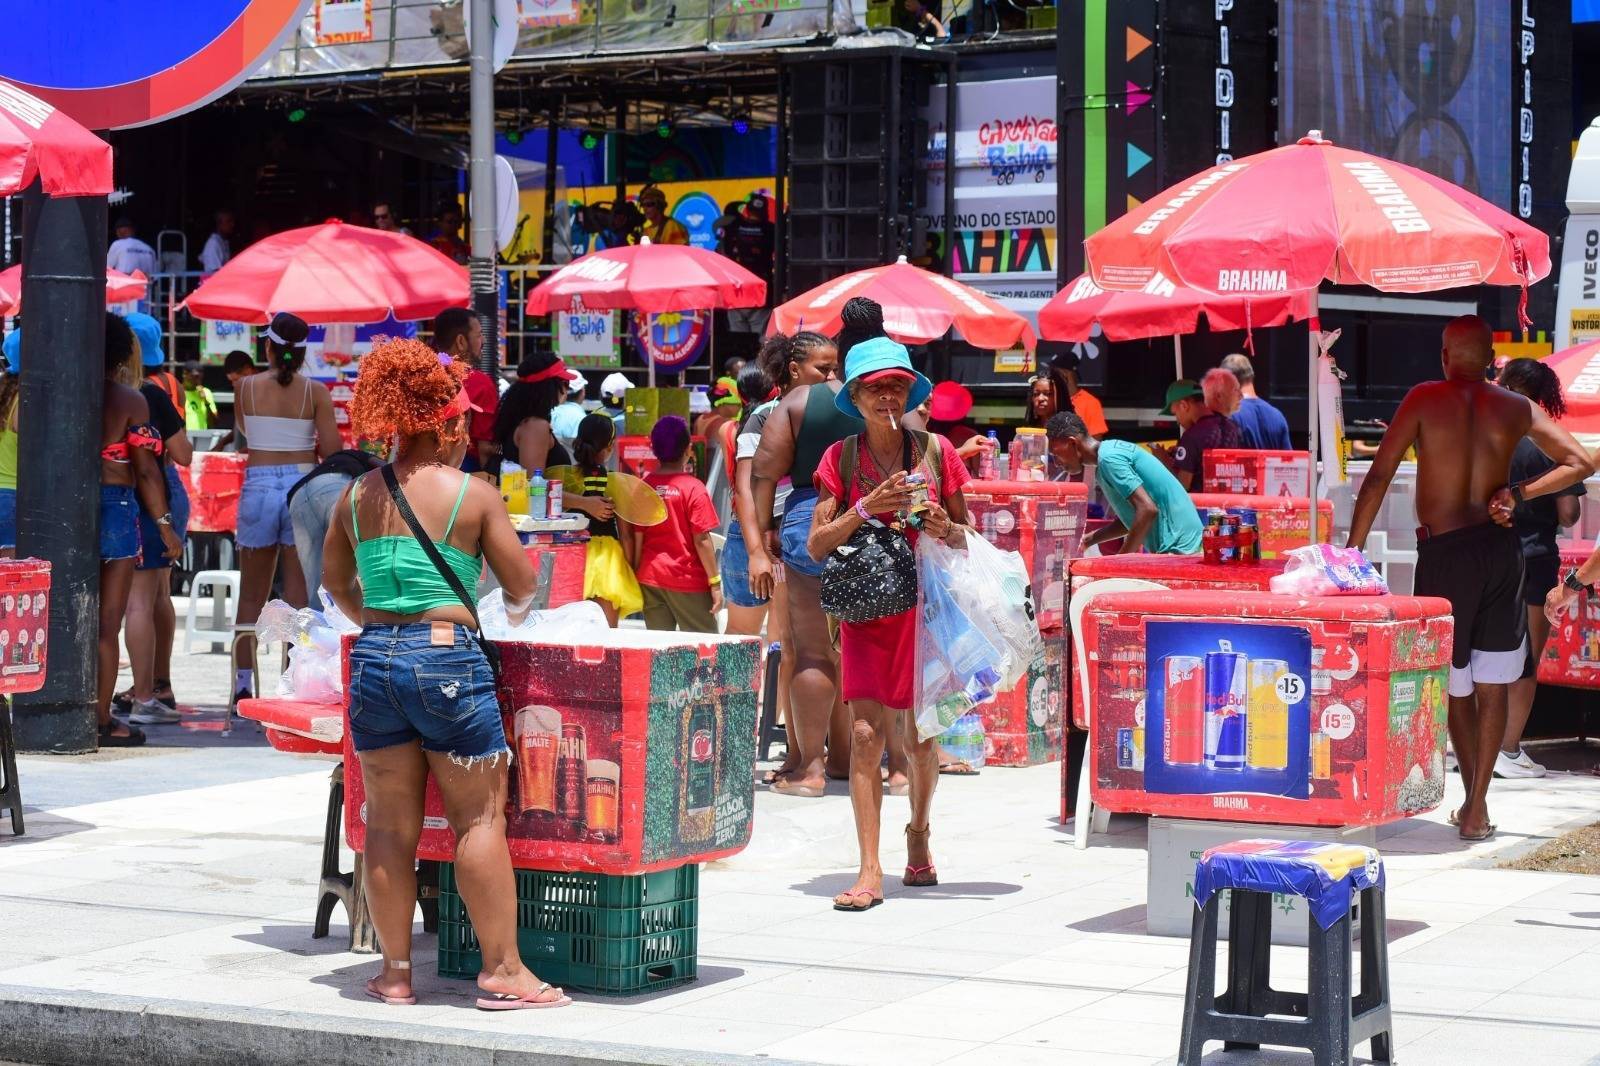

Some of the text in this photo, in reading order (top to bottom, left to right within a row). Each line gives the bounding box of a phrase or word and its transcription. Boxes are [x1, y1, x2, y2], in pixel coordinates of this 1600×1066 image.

[1343, 162, 1432, 234] BRAHMA
[981, 213, 1000, 228] DO
[1004, 210, 1056, 227] ESTADO
[1583, 229, 1599, 300] IVECO
[1217, 270, 1288, 293] BRAHMA
[1283, 677, 1299, 694] 15
[1325, 713, 1341, 729] 15
[527, 737, 550, 748] MALTE
[589, 783, 615, 797] BRAHMA
[715, 795, 745, 820] SABOR
[1213, 796, 1249, 809] BRAHMA
[715, 824, 736, 846] ZERO
